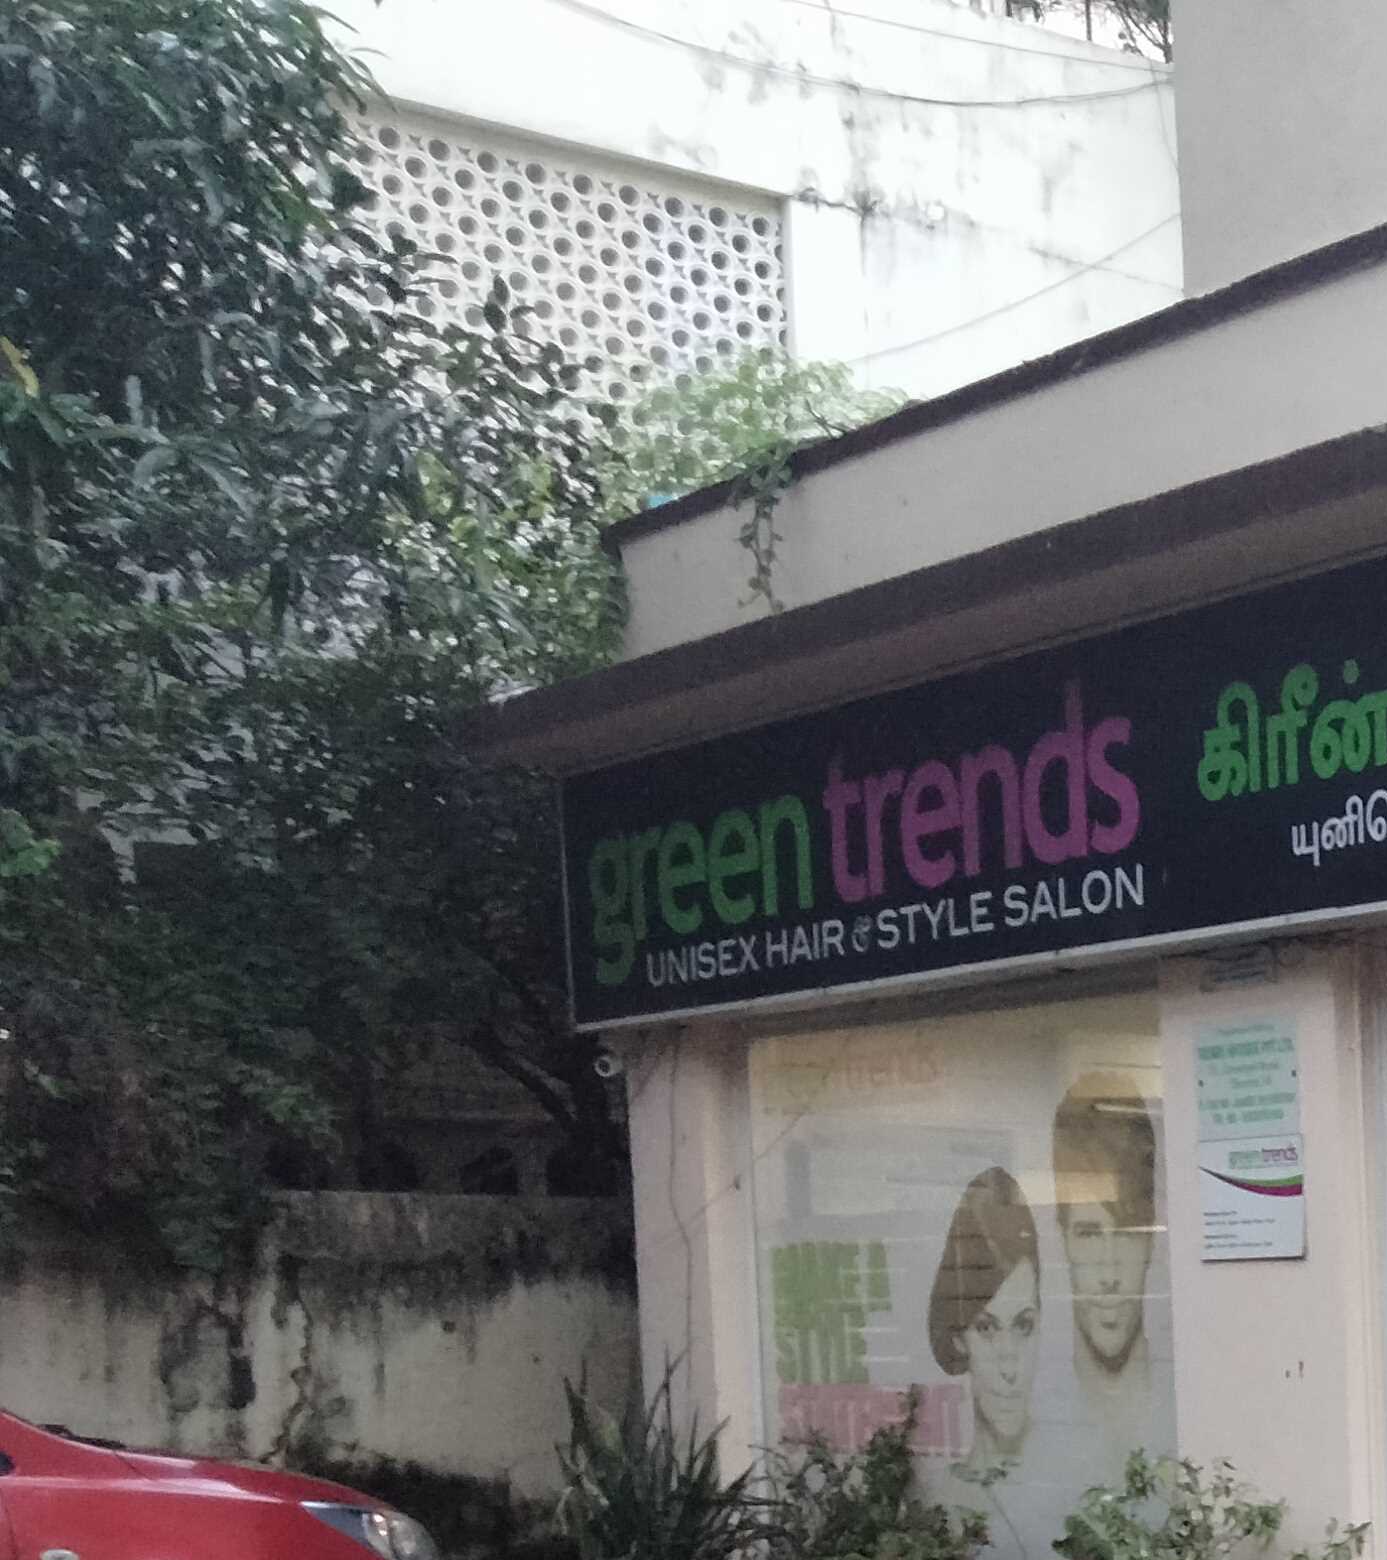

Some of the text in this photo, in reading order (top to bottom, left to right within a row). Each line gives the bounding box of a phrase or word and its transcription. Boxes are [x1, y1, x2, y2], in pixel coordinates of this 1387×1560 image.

[588, 678, 1142, 985] green trends
[645, 934, 760, 988] UNISEX
[764, 918, 846, 968] HAIR
[875, 889, 994, 950] STYLE
[1003, 863, 1146, 928] SALON
